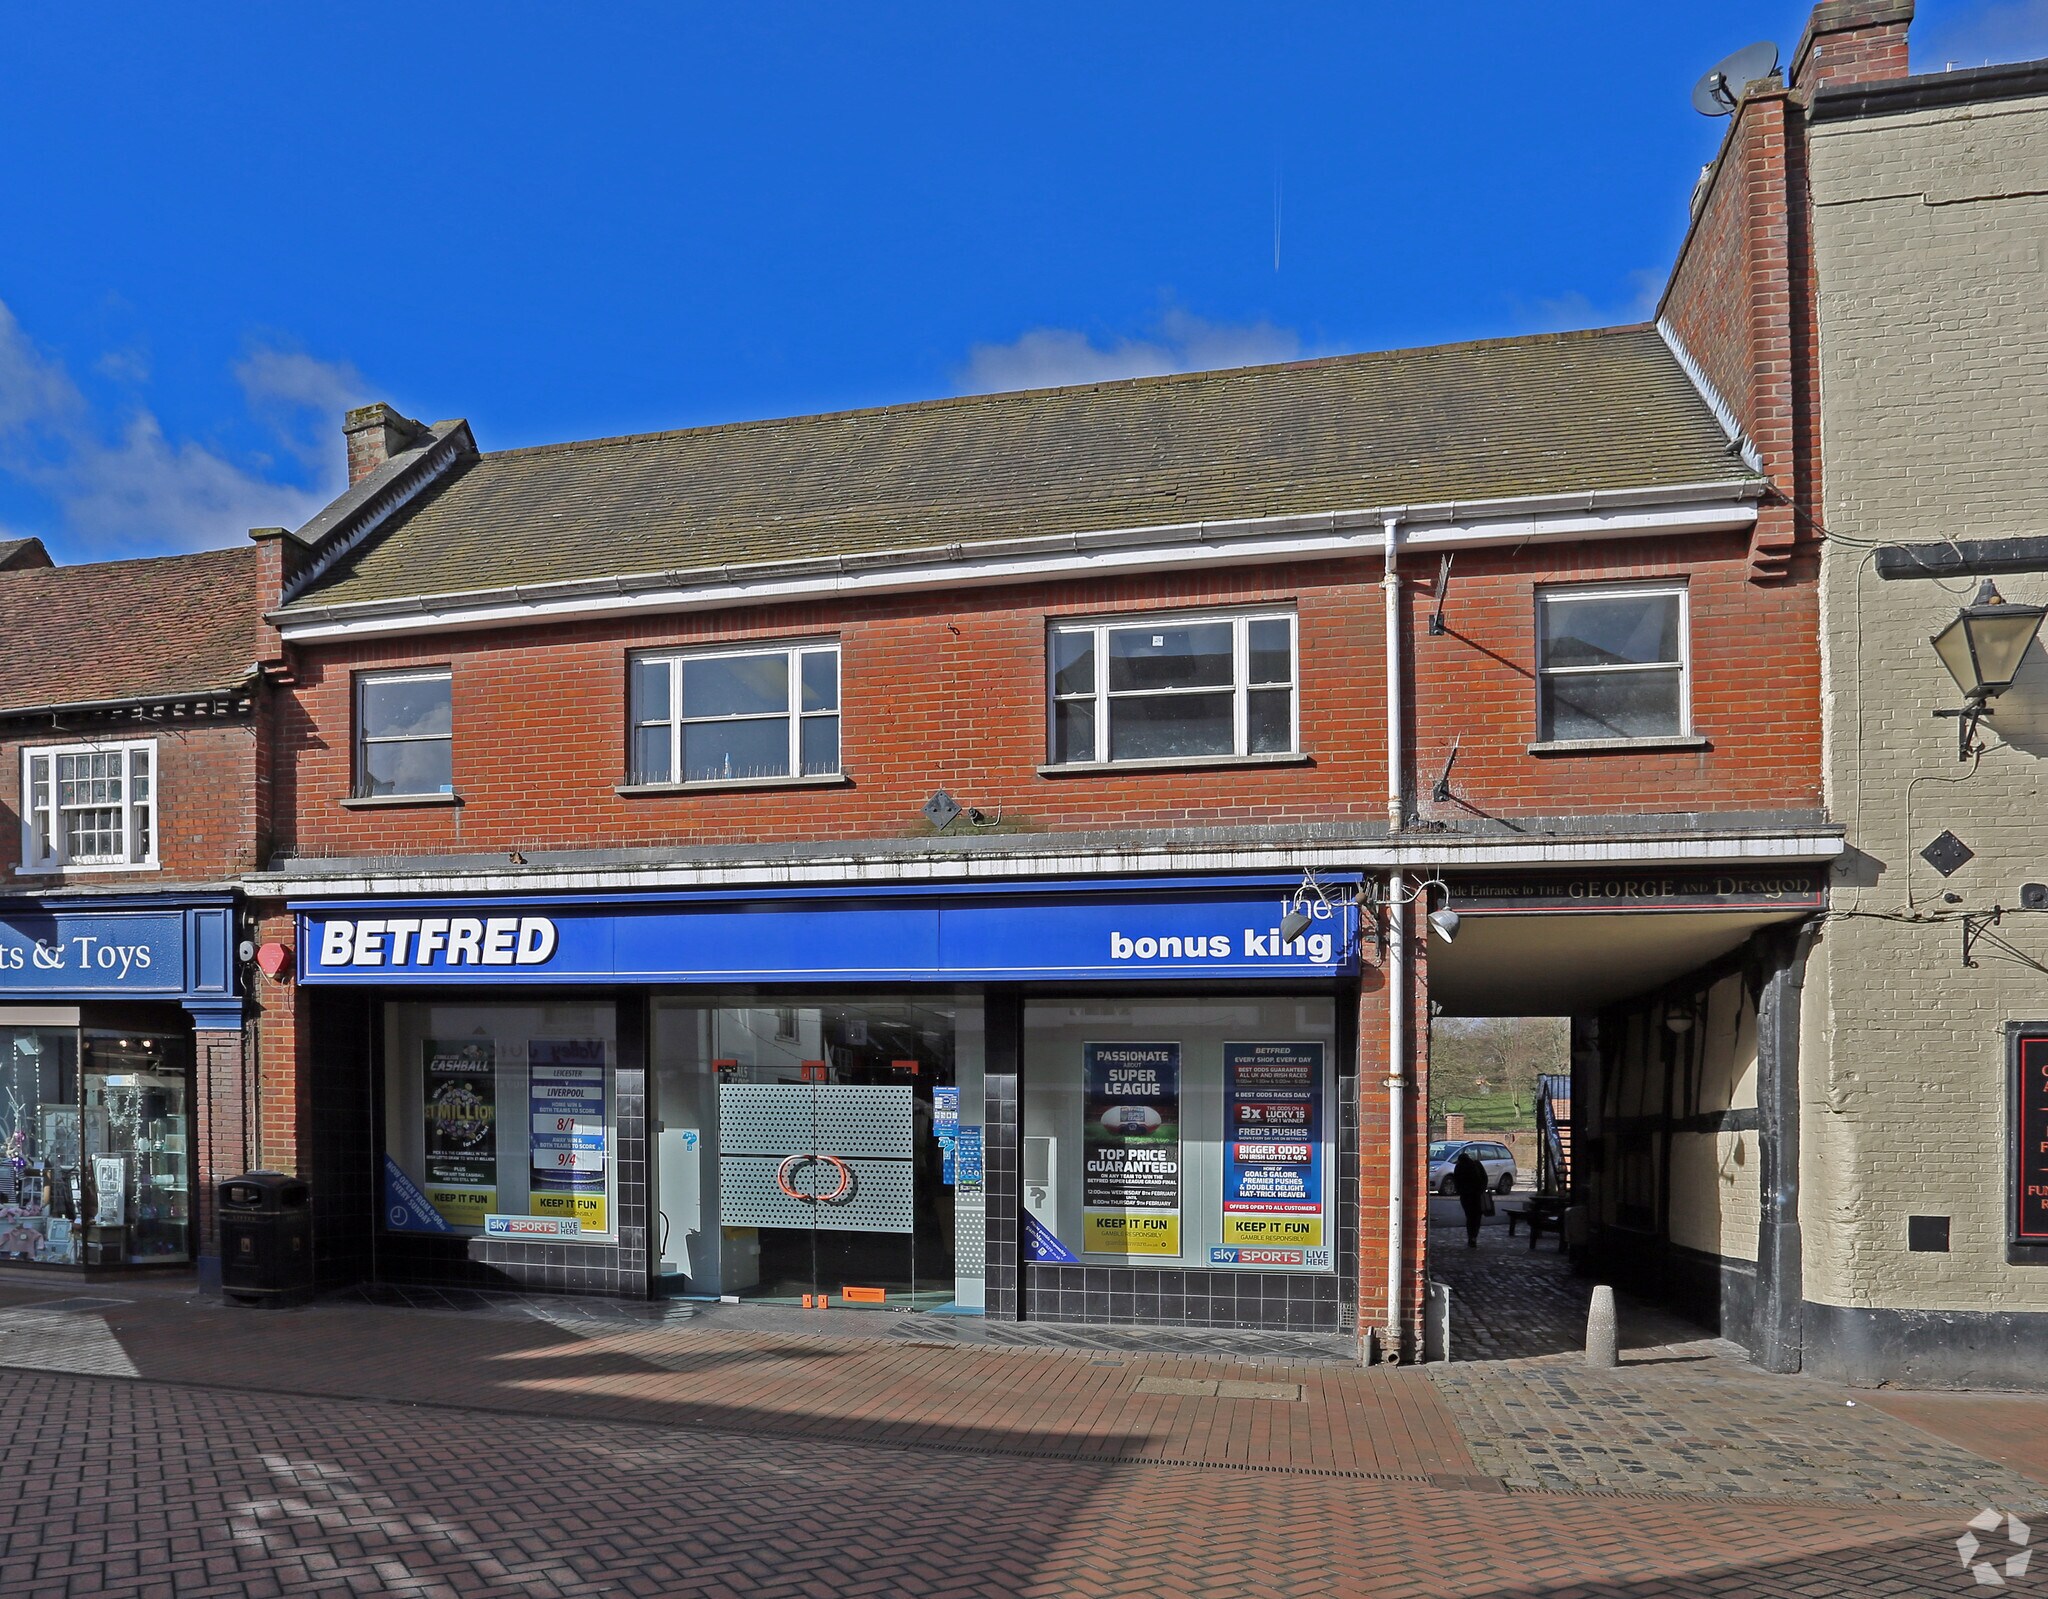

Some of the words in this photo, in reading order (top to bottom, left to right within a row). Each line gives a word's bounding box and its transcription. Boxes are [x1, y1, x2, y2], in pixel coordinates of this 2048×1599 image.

[1446, 885, 1467, 897] ide
[1471, 885, 1520, 896] Entrance
[1522, 885, 1533, 895] to
[1539, 885, 1563, 895] THE
[1568, 880, 1675, 899] GEORGE
[1680, 884, 1708, 893] AND
[1713, 877, 1810, 899] Dragon
[320, 917, 558, 966] BETFRED
[1110, 932, 1231, 959] bonus
[1244, 928, 1332, 964] king
[32, 938, 65, 969] &
[72, 936, 151, 980] Toys
[1097, 1051, 1168, 1061] PASSIONATE
[430, 1060, 489, 1072] CASHBALL
[553, 1069, 582, 1077] LEICESTER
[1109, 1069, 1156, 1082] SUPER
[547, 1088, 584, 1098] LIVERPOOL
[1104, 1083, 1160, 1095] LEAGUE
[438, 1104, 495, 1120] MILLION
[1241, 1106, 1261, 1119] 3x
[557, 1118, 575, 1131] 8/1
[1239, 1128, 1270, 1136] FRED'S
[1272, 1128, 1308, 1136] PUSHES
[1098, 1149, 1125, 1160] TOP
[1128, 1149, 1166, 1161] PRICE
[1239, 1145, 1276, 1154] BIGGER
[1278, 1146, 1307, 1155] ODDS
[558, 1153, 576, 1167] 9/4
[1087, 1161, 1177, 1173] GUARANTEED
[386, 1161, 401, 1178] NOW
[399, 1176, 415, 1194] OPEN
[413, 1192, 431, 1212] FROM
[392, 1181, 410, 1201] EVERY
[407, 1200, 431, 1224] SUNDAY
[434, 1193, 456, 1202] KEEP
[458, 1194, 466, 1203] IT
[469, 1195, 487, 1204] FUN
[540, 1198, 564, 1207] KEEP
[566, 1199, 574, 1208] IT
[577, 1200, 597, 1209] FUN
[490, 1220, 508, 1232] sky
[512, 1221, 557, 1232] SPORTS
[1097, 1219, 1126, 1228] KEEP
[1130, 1220, 1140, 1229] IT
[1144, 1220, 1167, 1230] FUN
[1236, 1222, 1266, 1232] KEEP
[1270, 1223, 1281, 1232] IT
[1285, 1223, 1309, 1233] FUN
[1213, 1249, 1236, 1262] sky
[1241, 1251, 1300, 1262] SPORTS
